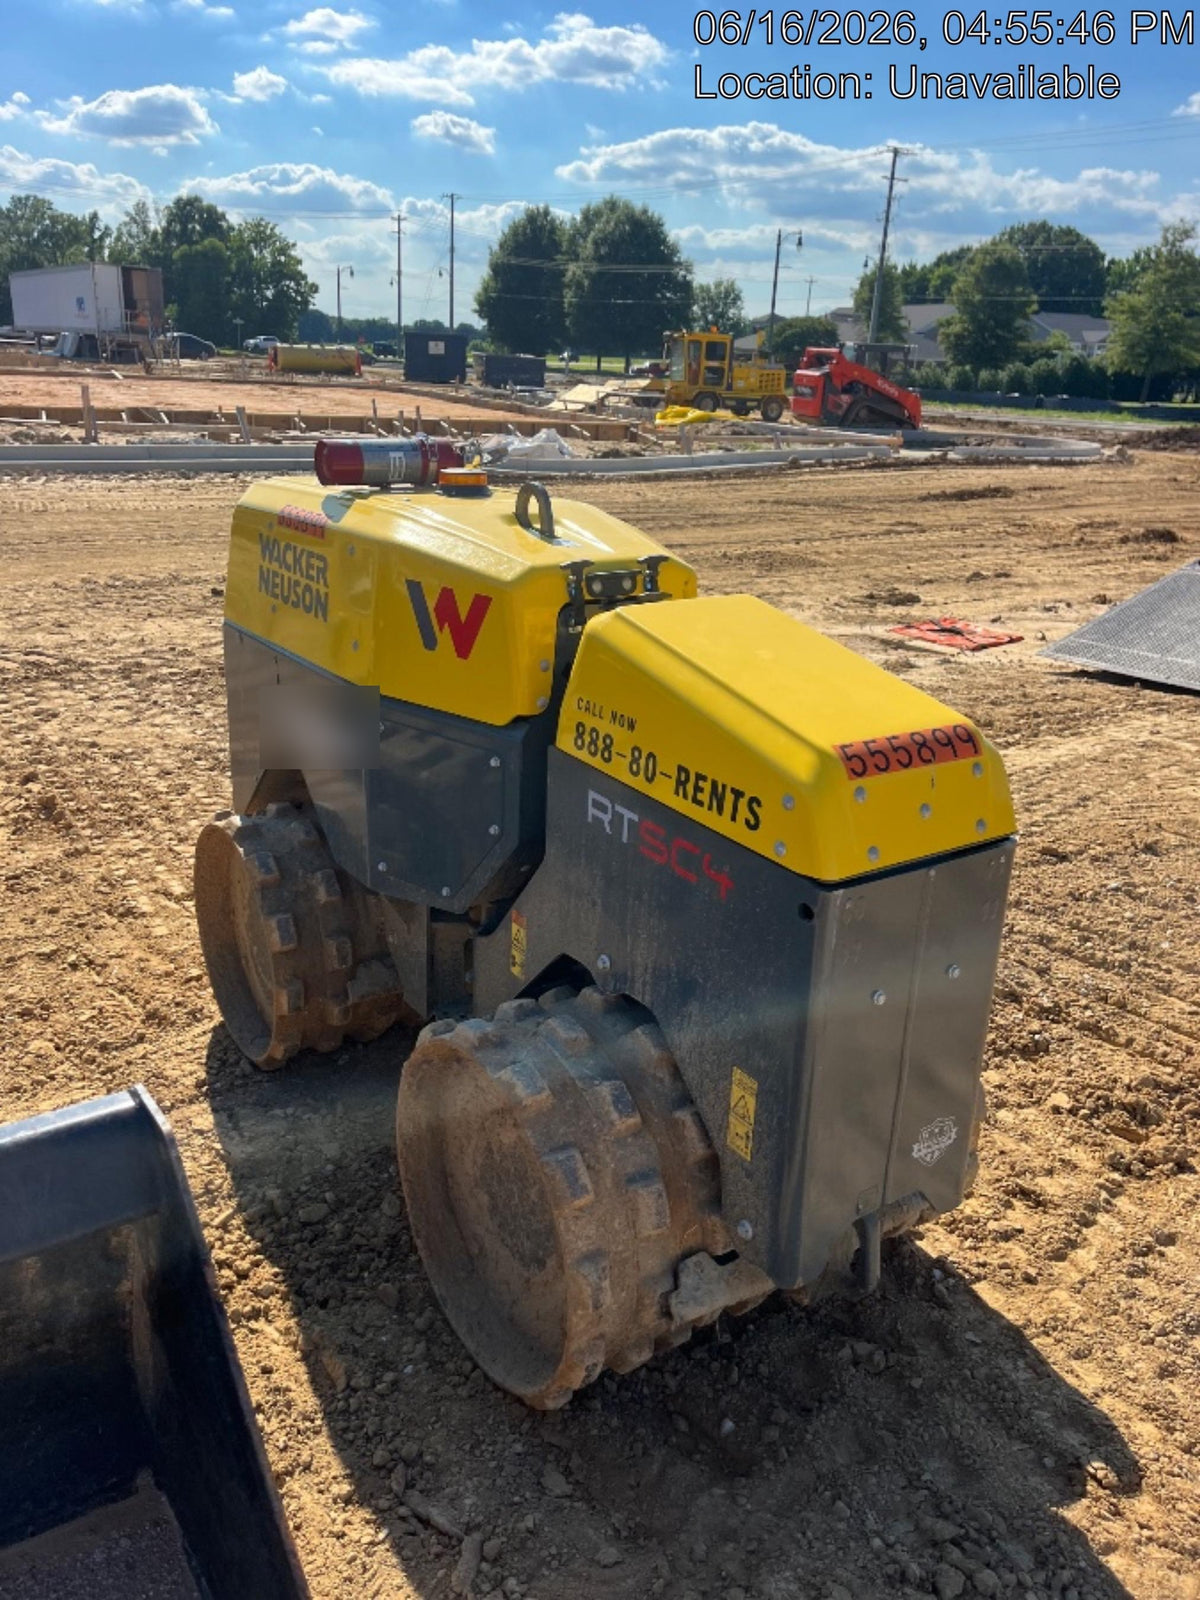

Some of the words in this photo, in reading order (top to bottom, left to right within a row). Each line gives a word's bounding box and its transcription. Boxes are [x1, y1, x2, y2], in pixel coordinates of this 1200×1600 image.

[258, 532, 329, 589] WACKER
[258, 565, 329, 623] NEUSON
[577, 696, 604, 720] CALL
[609, 710, 638, 733] NOW
[573, 721, 763, 831] 888-80-RENTS
[839, 724, 979, 778] 555899
